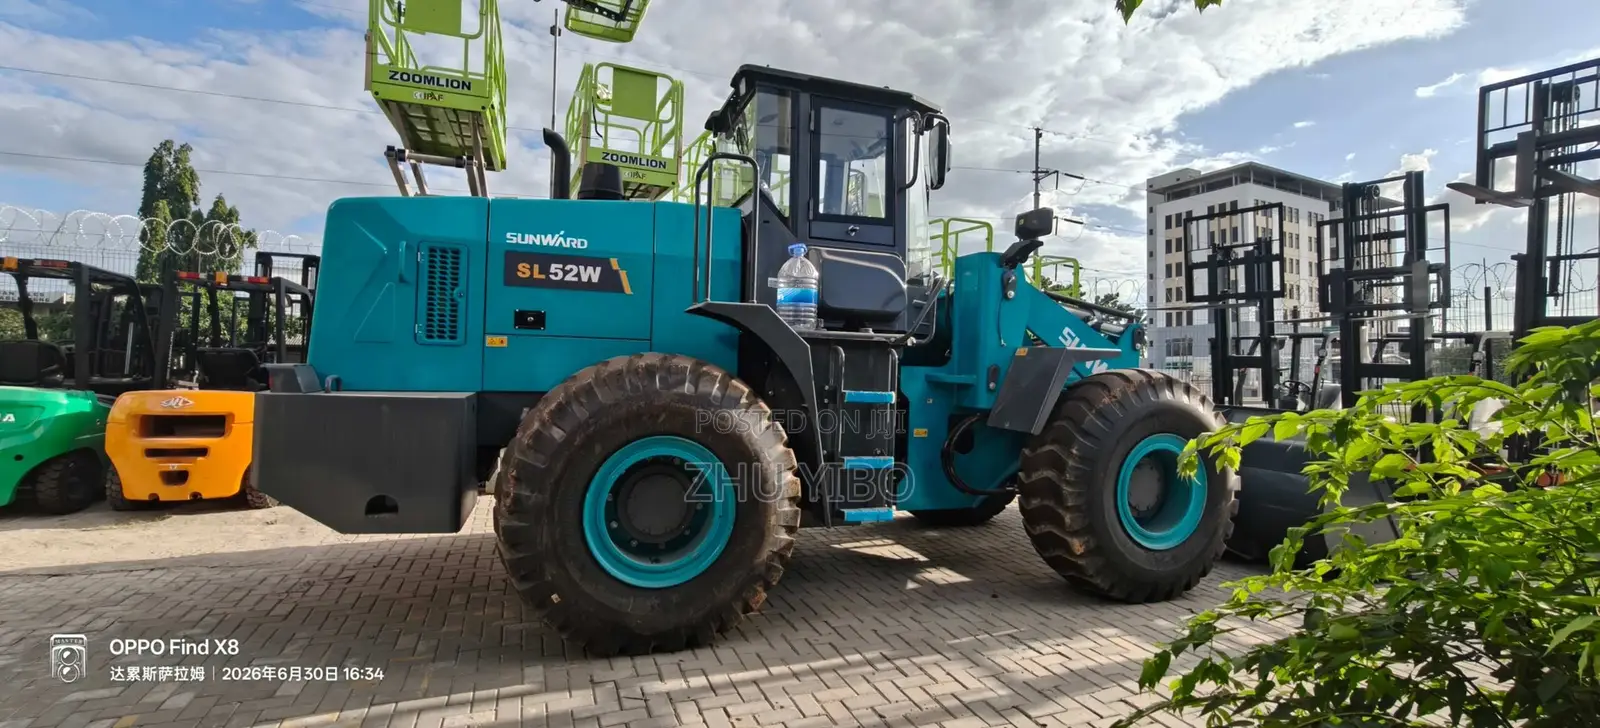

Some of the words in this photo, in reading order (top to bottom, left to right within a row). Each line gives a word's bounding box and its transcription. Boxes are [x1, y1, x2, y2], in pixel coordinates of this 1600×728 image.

[389, 70, 471, 91] ZOOMLION
[602, 152, 667, 169] ZOOMLION
[506, 230, 588, 249] SUNWARD
